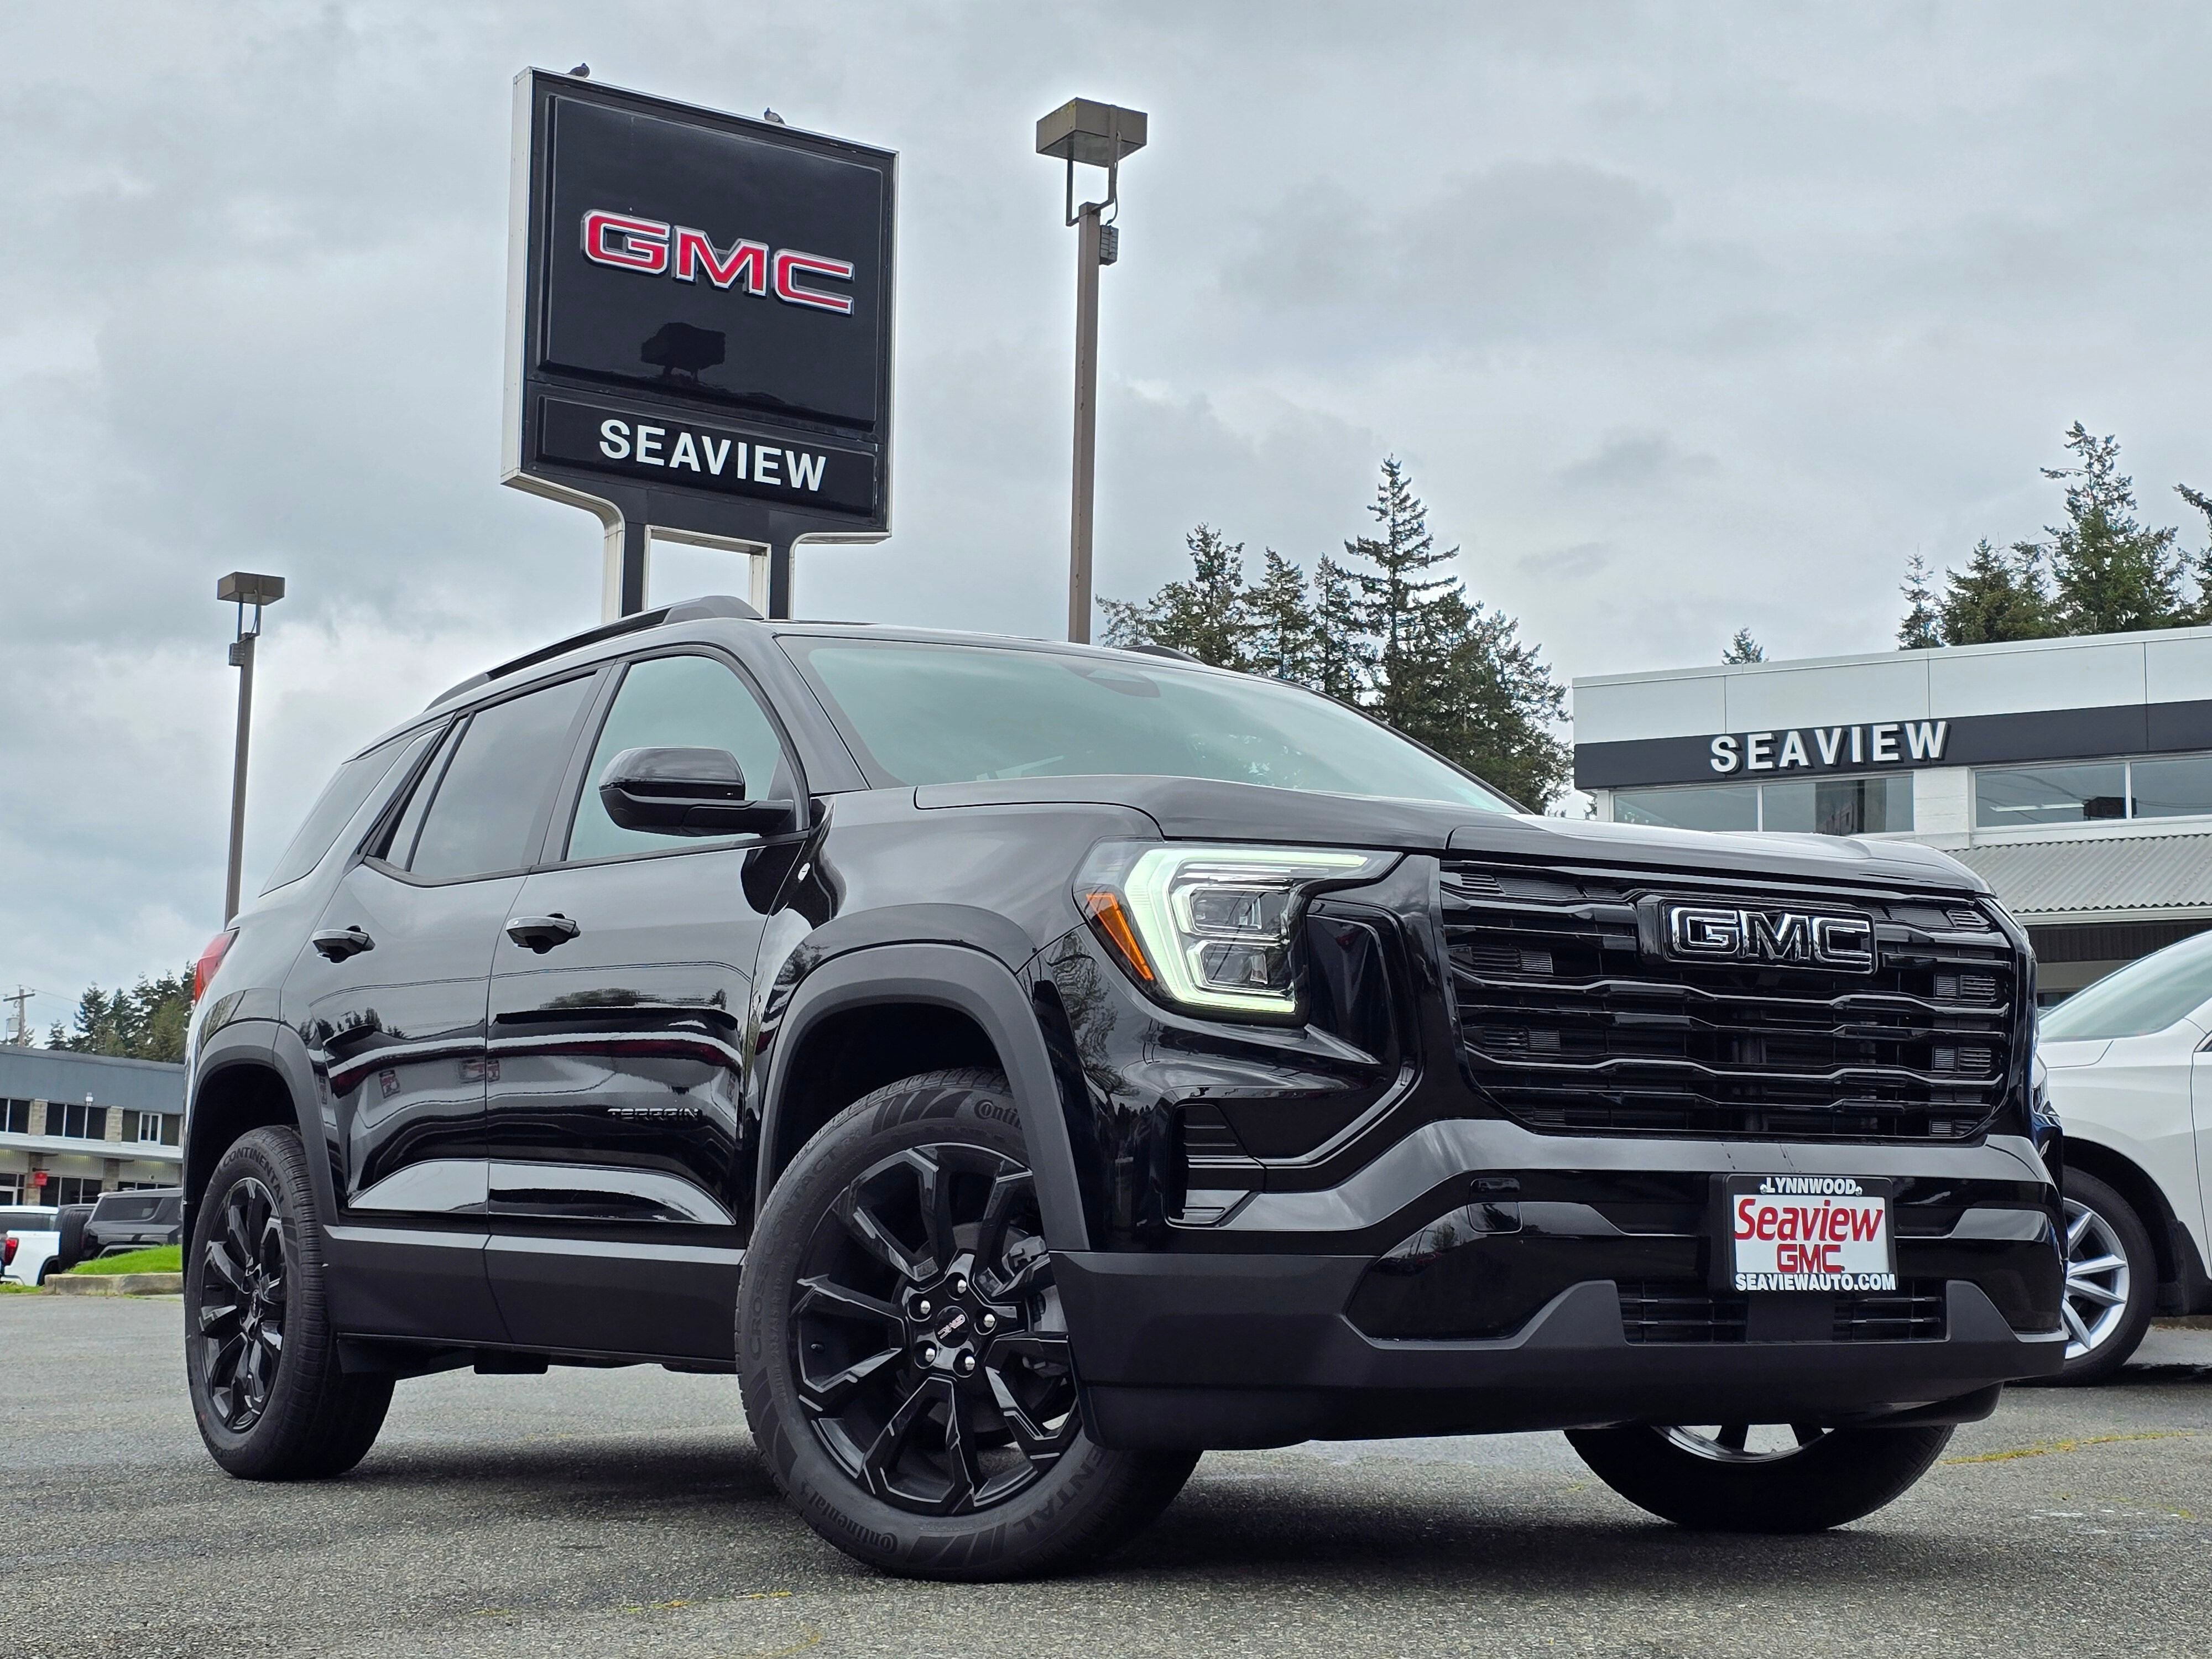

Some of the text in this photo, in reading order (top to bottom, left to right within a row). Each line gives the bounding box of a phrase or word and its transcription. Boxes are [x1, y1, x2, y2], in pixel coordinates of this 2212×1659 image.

[583, 209, 854, 314] GMC
[599, 419, 826, 491] SEAVIEW
[1710, 721, 1949, 774] SEAVIEW
[1671, 906, 1872, 969] GMC
[607, 1108, 701, 1121] TERRAIN
[223, 1147, 284, 1205] CONTINENTAL
[1766, 1177, 1856, 1194] LYNNWOOD
[1734, 1198, 1884, 1242] Seaview
[1735, 1274, 1896, 1291] SEAVIEWAUTO.COM
[1777, 1244, 1842, 1273] GMC
[808, 1491, 898, 1554] Continental
